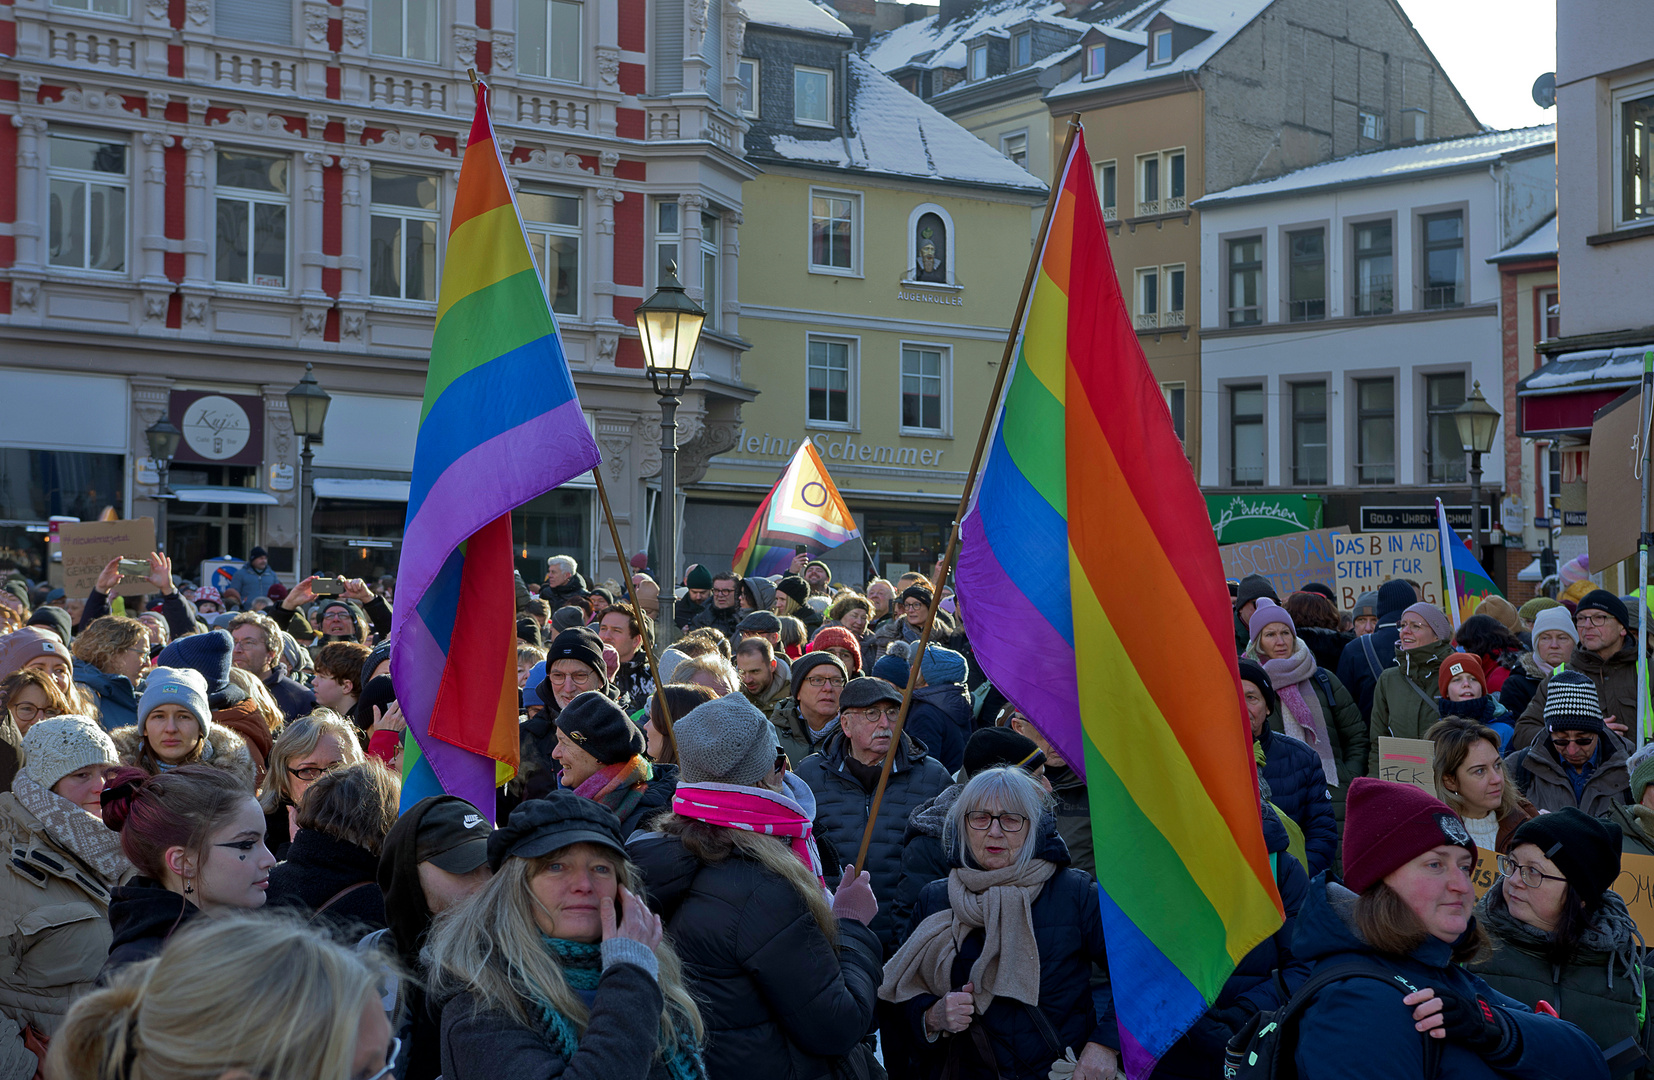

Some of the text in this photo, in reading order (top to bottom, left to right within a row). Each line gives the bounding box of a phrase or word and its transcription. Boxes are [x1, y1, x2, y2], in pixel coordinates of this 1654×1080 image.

[897, 291, 963, 306] AUGENROLLER
[812, 432, 944, 467] Schemmer
[1335, 533, 1437, 555] DAS B IN AfD
[1337, 557, 1423, 579] STEHT FÜR
[1381, 766, 1425, 786] FCK
[464, 814, 479, 823] NIKE
